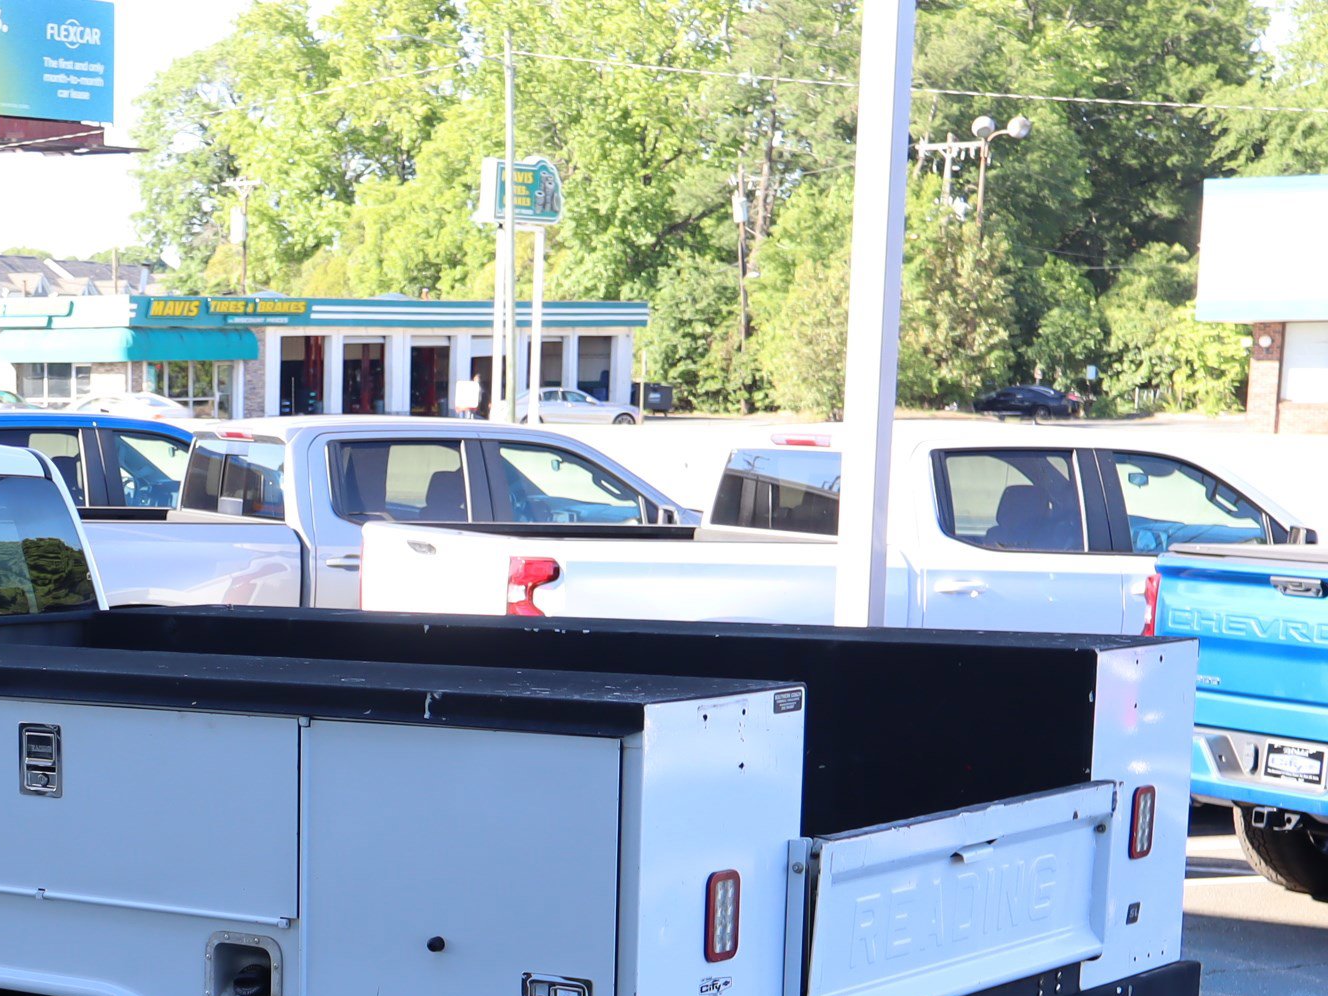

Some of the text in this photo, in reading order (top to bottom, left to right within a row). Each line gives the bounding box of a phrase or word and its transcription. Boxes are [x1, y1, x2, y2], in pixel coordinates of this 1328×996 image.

[46, 22, 101, 45] FLEXCAR
[43, 56, 58, 68] The
[74, 61, 88, 71] and
[88, 62, 105, 75] only
[150, 300, 201, 317] MAVIS
[209, 301, 246, 313] TIRES
[257, 301, 307, 313] BRAKES
[849, 853, 1057, 970] READING
